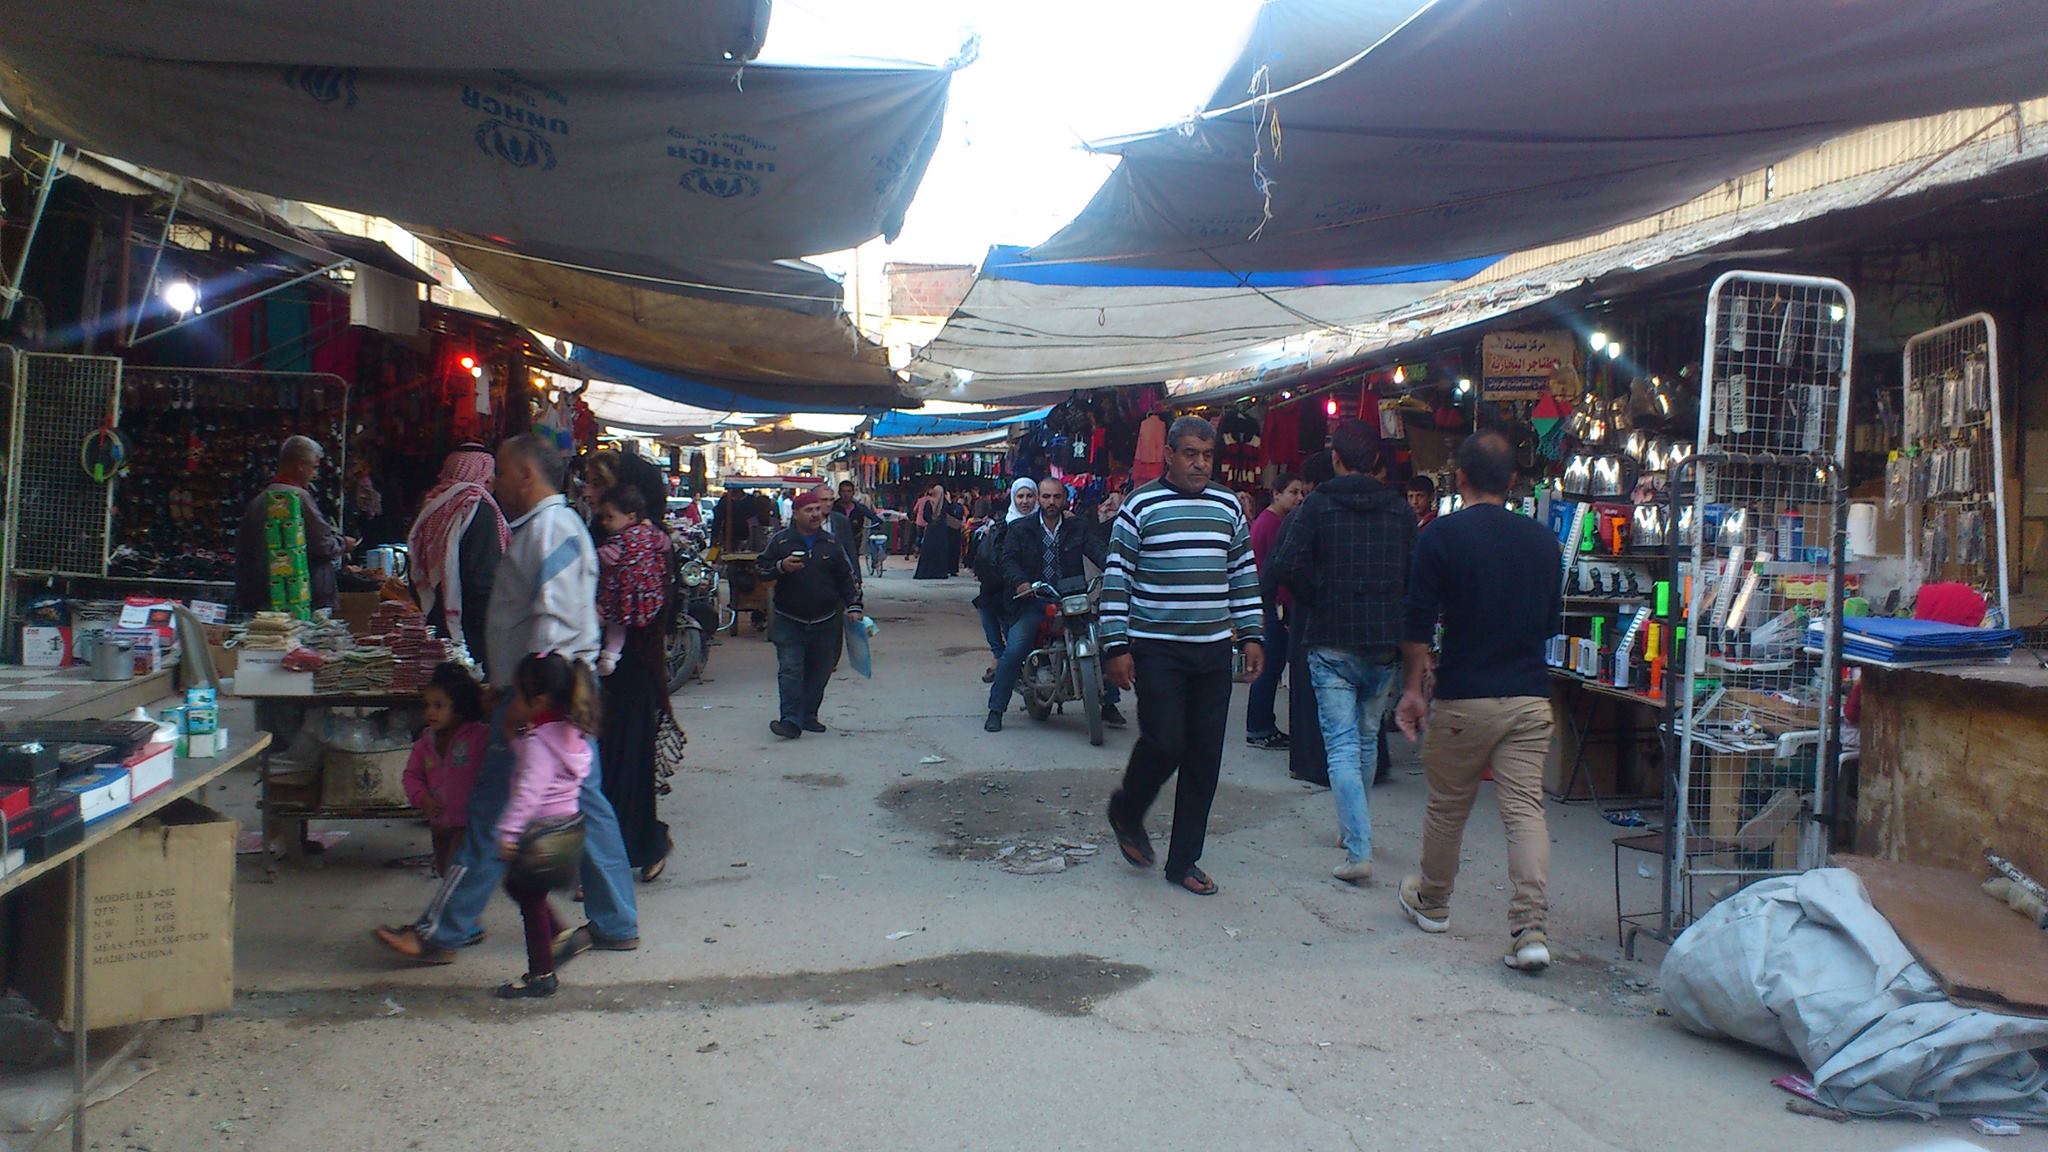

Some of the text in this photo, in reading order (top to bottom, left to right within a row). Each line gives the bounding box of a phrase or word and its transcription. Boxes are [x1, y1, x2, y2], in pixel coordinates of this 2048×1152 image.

[461, 86, 570, 136] UNHCR
[666, 145, 776, 173] UNHCR
[93, 948, 173, 965] MADE IN CHINA
